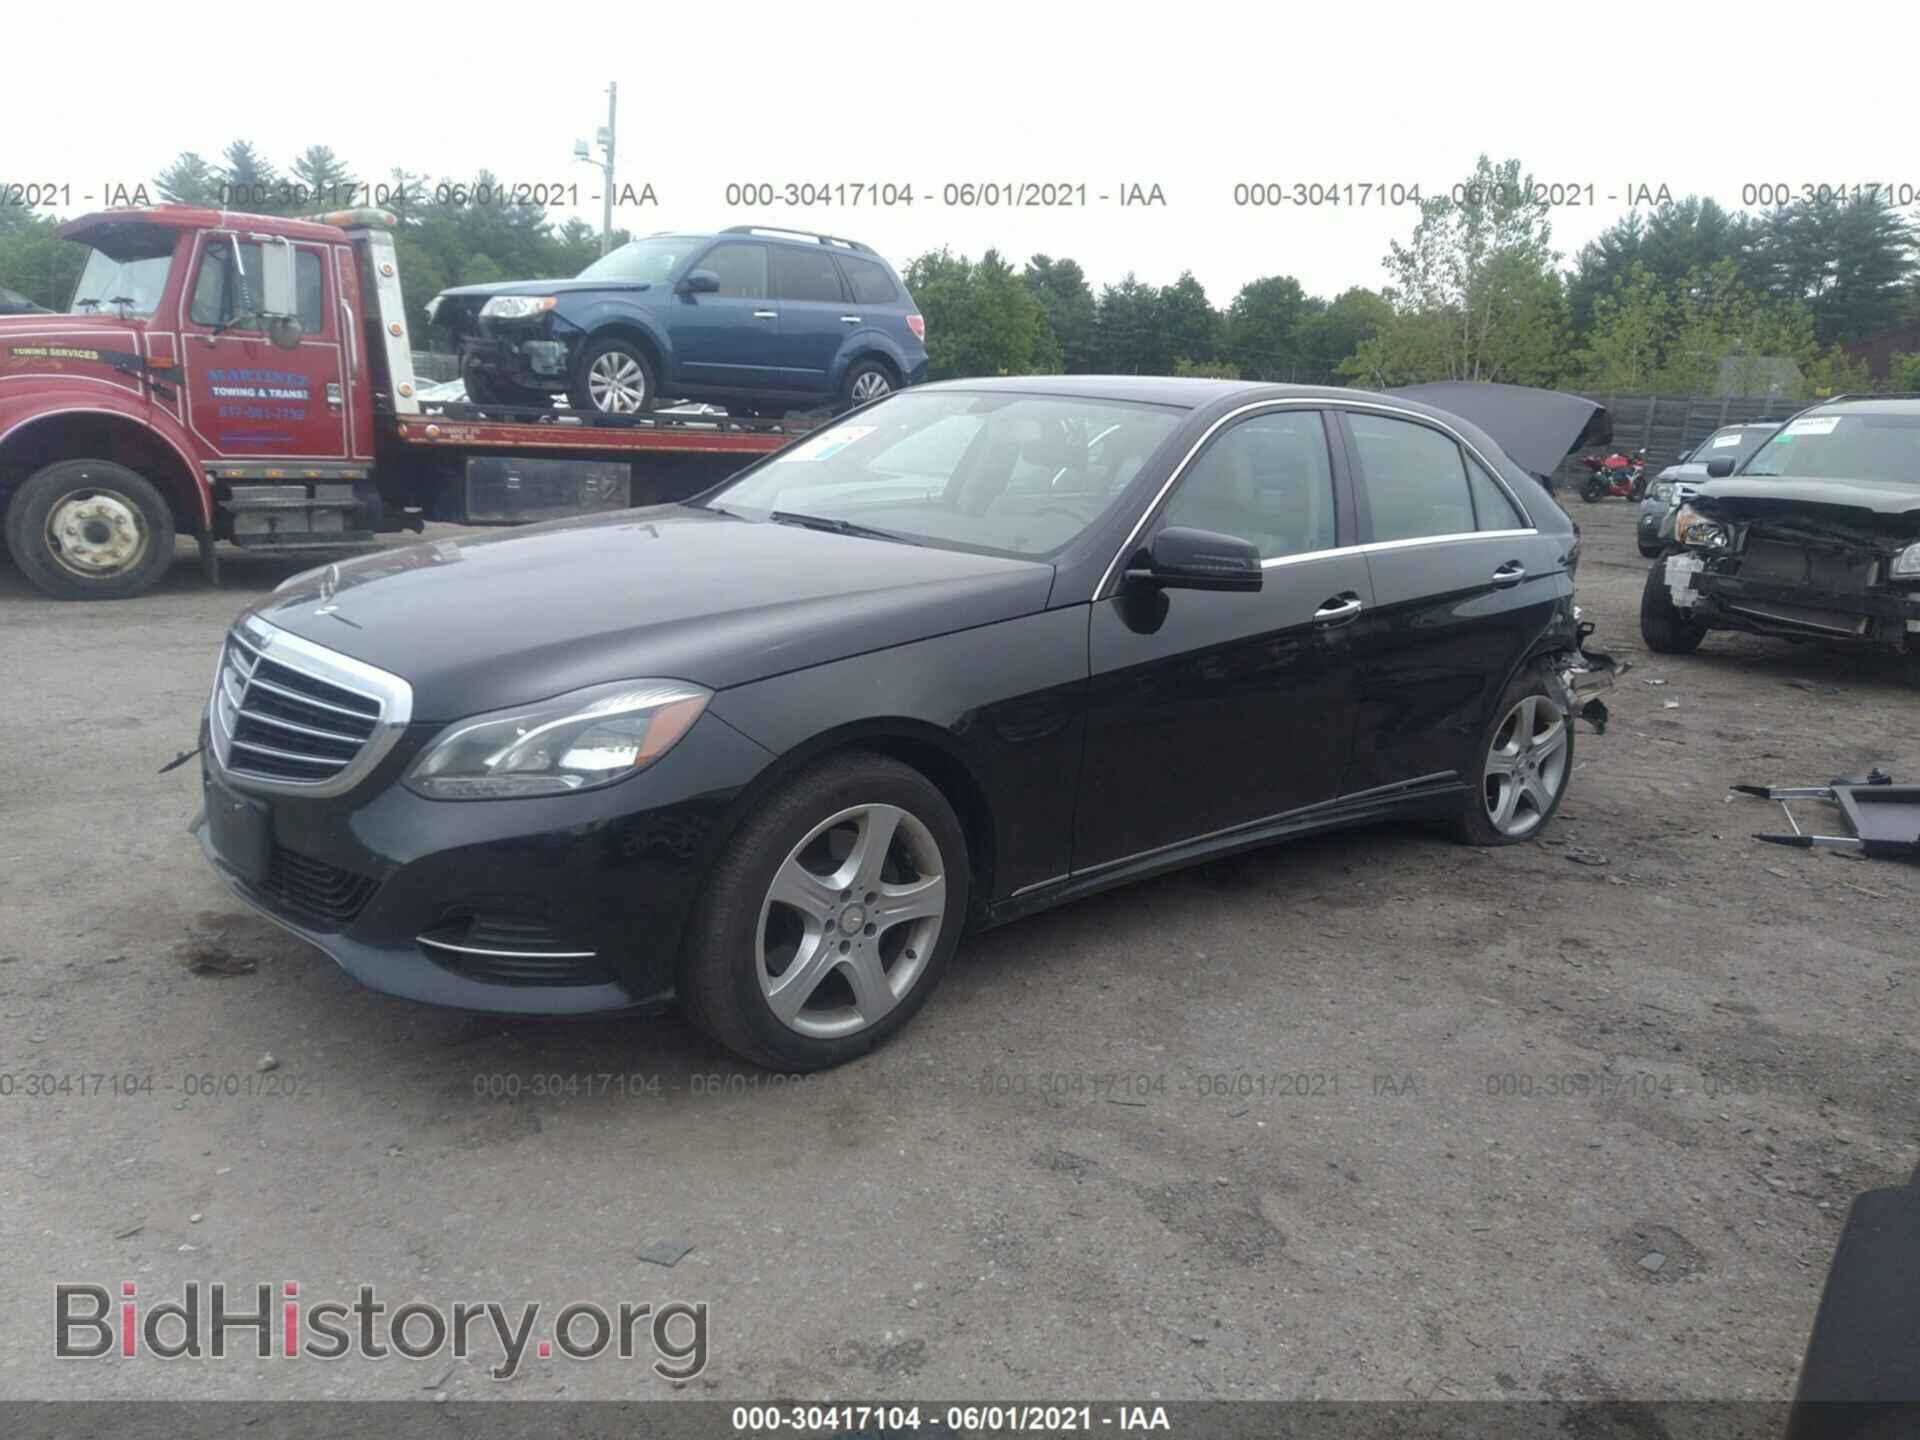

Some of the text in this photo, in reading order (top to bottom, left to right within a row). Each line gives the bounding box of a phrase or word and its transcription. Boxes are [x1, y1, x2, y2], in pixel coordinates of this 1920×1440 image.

[49, 348, 99, 360] SERVICES
[212, 387, 256, 397] TOWING
[258, 388, 267, 397] &
